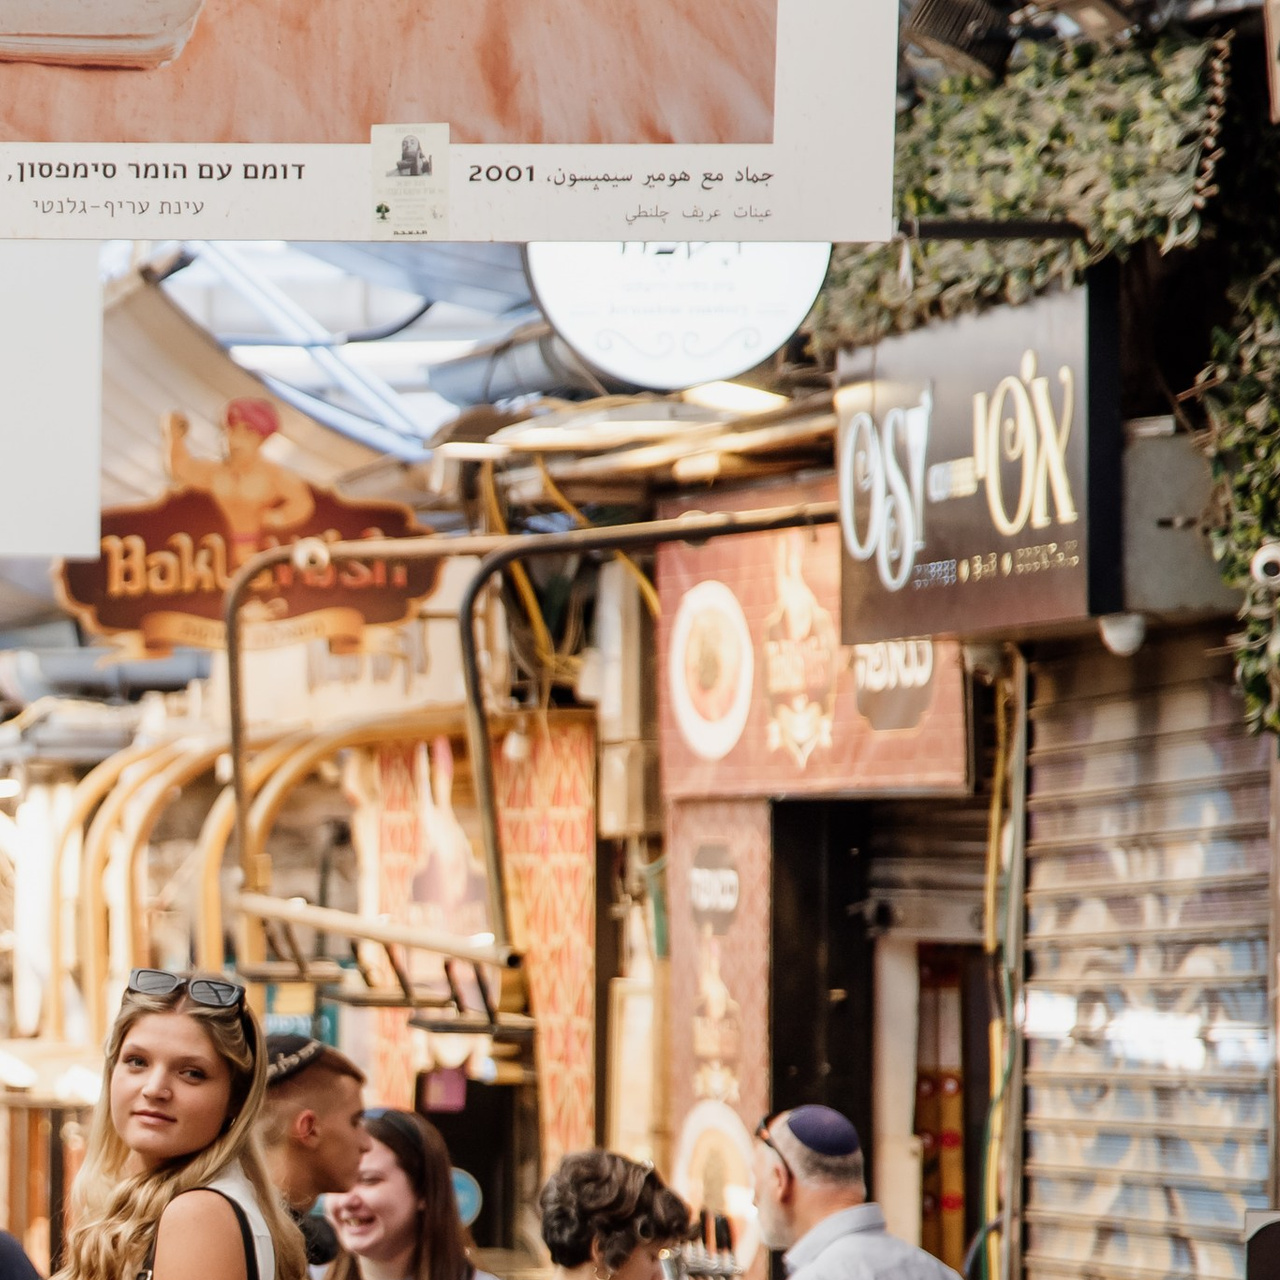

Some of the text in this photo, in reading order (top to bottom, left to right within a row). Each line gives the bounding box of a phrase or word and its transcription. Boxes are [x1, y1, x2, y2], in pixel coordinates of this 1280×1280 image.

[128, 163, 187, 180] הומר
[198, 163, 232, 180] עם
[243, 163, 305, 180] דומם
[469, 165, 534, 182] 2001
[735, 165, 774, 187] جماد
[701, 171, 724, 190] مع
[159, 201, 204, 215] עינת
